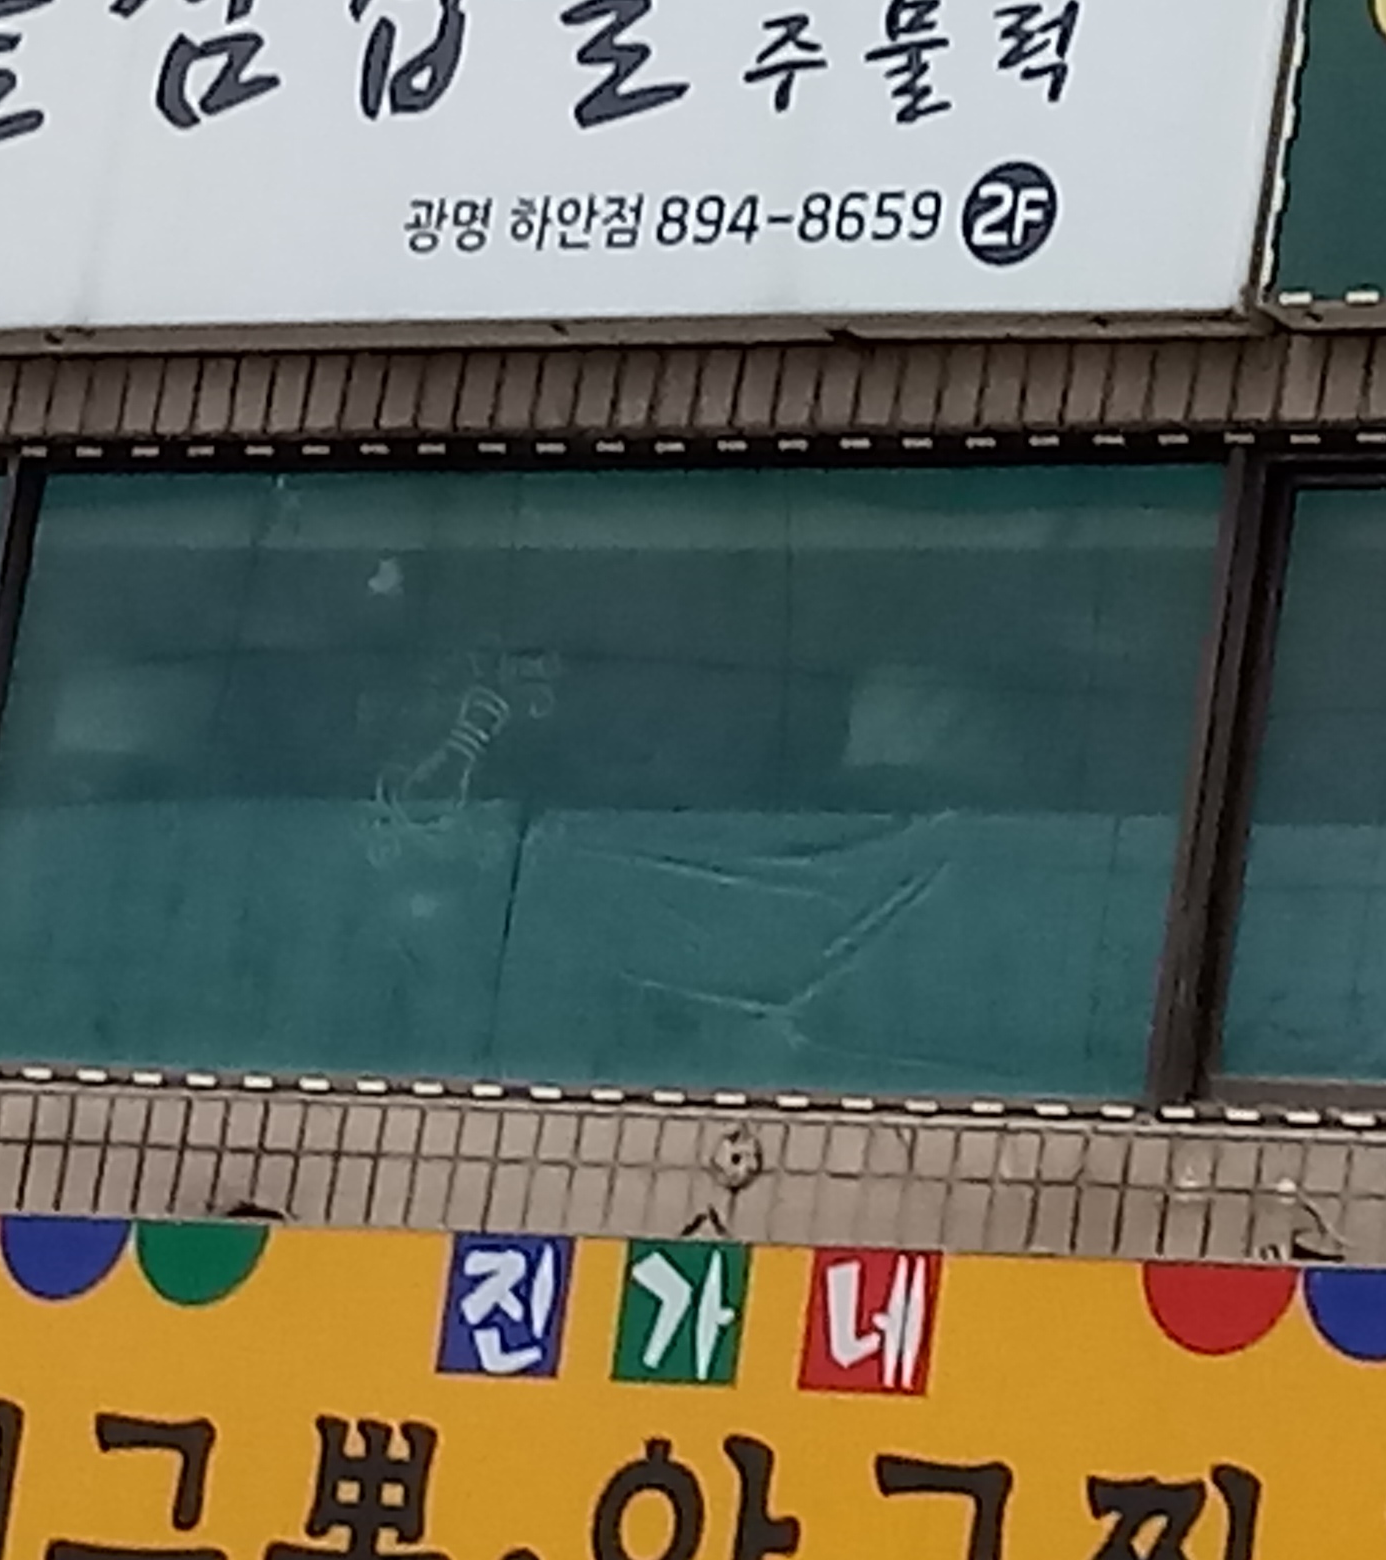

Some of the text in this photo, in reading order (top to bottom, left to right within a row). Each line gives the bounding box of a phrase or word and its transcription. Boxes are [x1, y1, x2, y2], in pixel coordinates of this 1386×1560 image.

[402, 172, 1054, 256] 광명 하안점 894-8659 2F
[460, 1243, 928, 1390] 진가네
